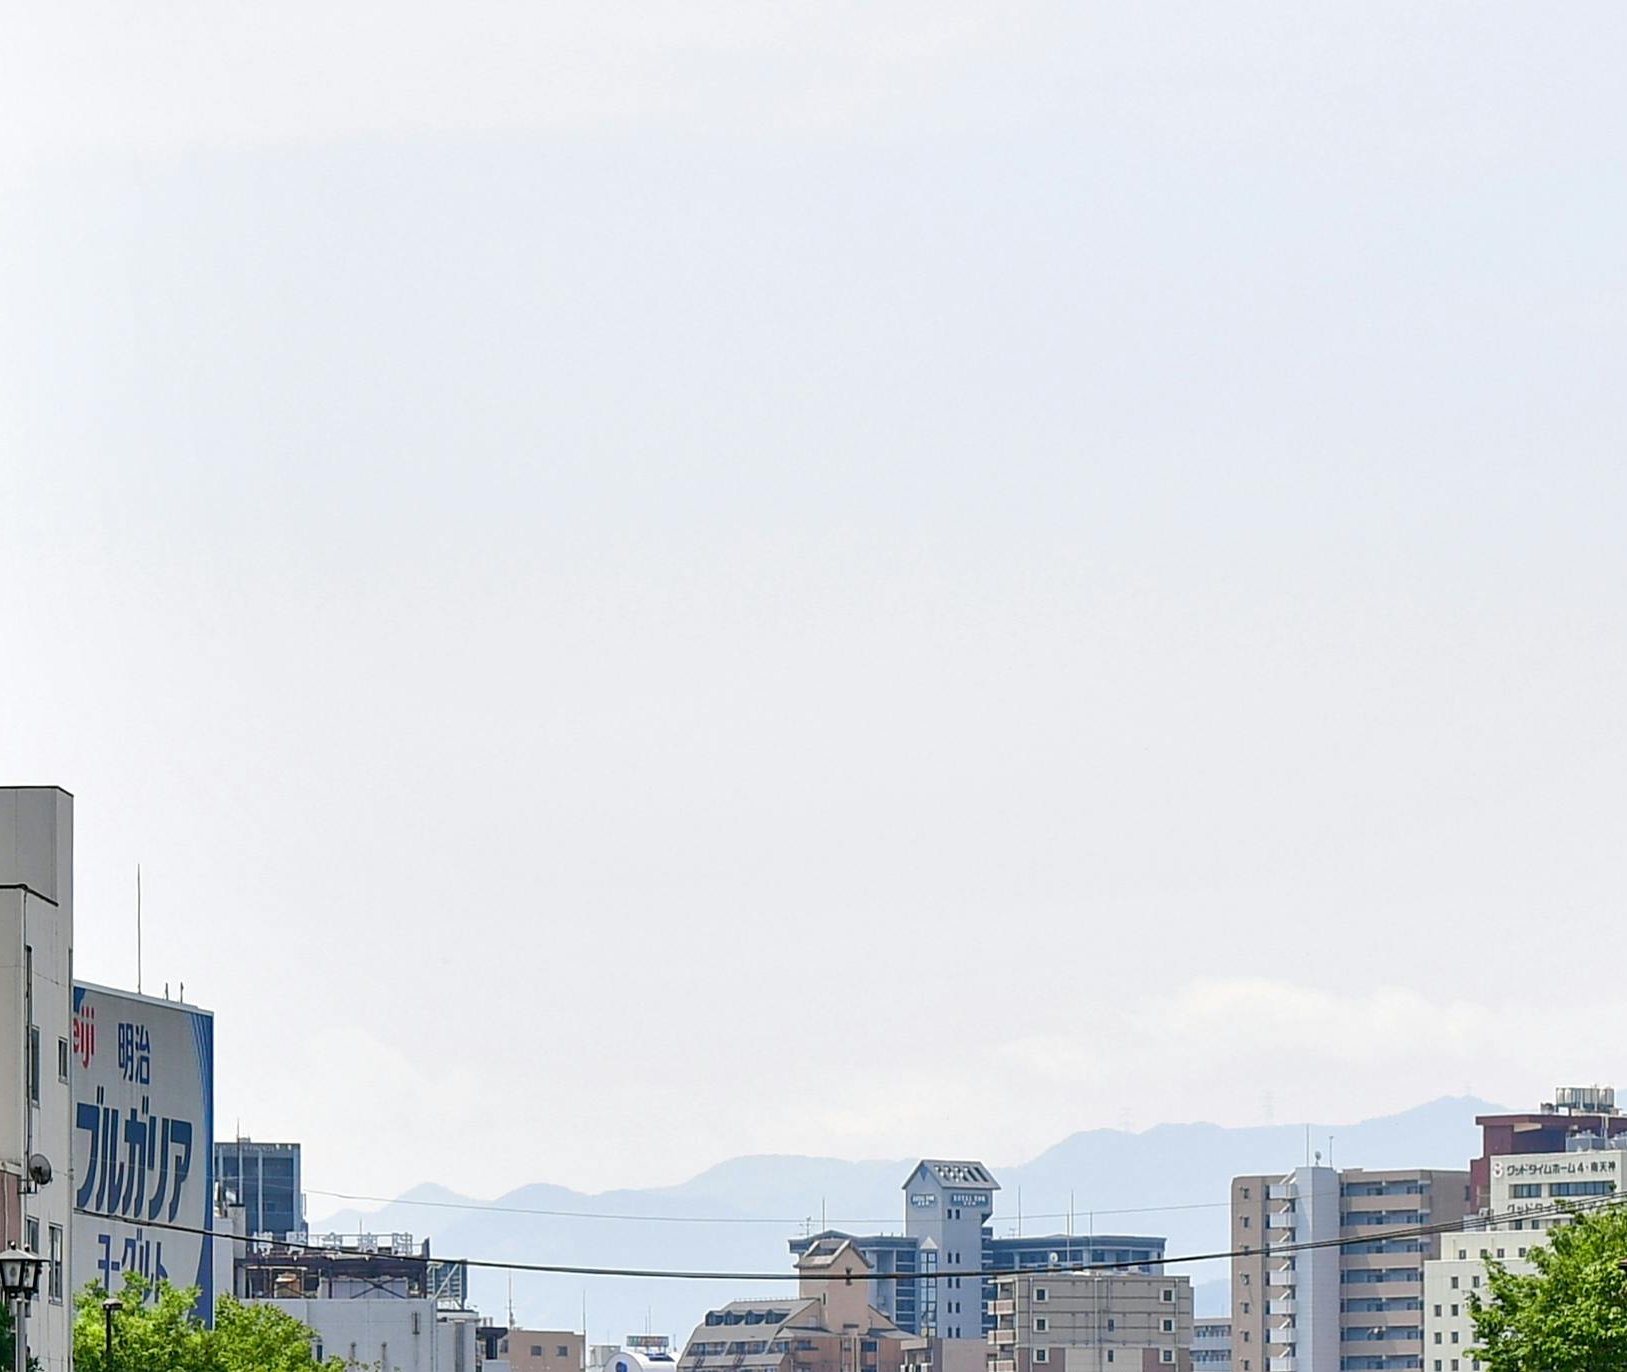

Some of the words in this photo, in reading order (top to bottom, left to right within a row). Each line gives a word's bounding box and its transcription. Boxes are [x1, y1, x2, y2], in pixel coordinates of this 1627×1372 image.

[118, 1022, 150, 1086] 明治
[76, 1086, 192, 1223] ブルガリア
[97, 1228, 169, 1304] ヨーグルト
